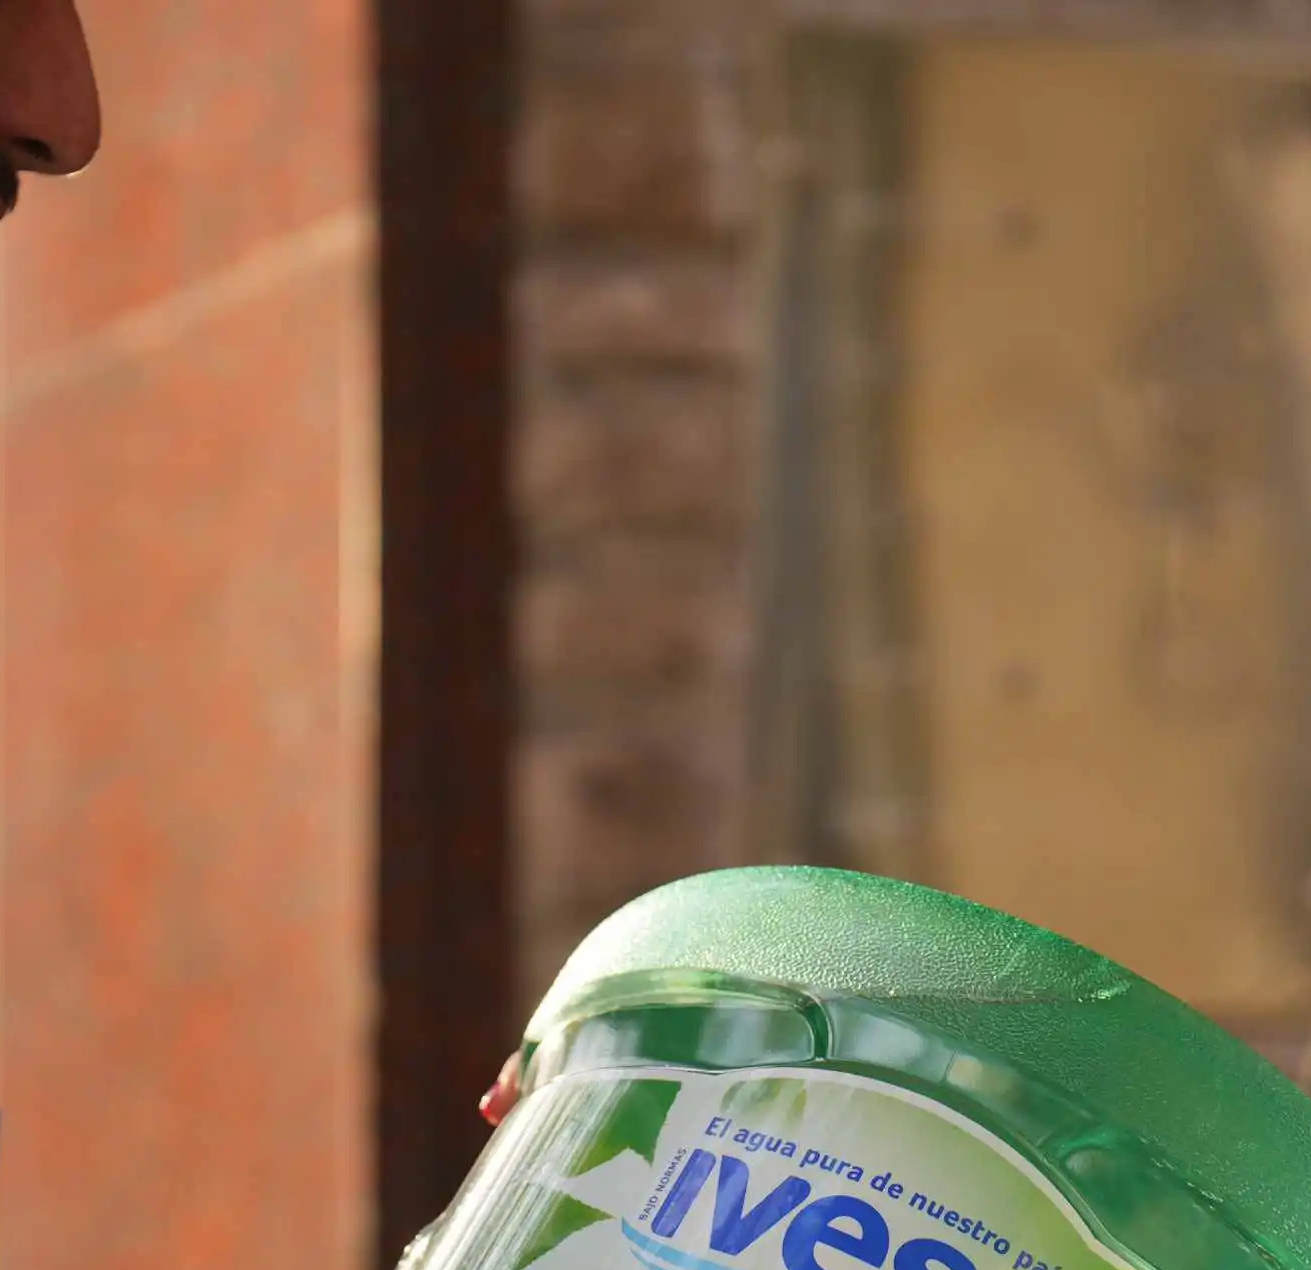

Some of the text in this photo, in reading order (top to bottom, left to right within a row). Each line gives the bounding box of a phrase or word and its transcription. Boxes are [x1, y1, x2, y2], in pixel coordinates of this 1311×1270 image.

[655, 1147, 687, 1192] NORMAS
[705, 1116, 732, 1138] El
[733, 1128, 797, 1158] agua
[799, 1149, 864, 1182] pura
[870, 1172, 904, 1199] de
[908, 1192, 1011, 1255] nuestro
